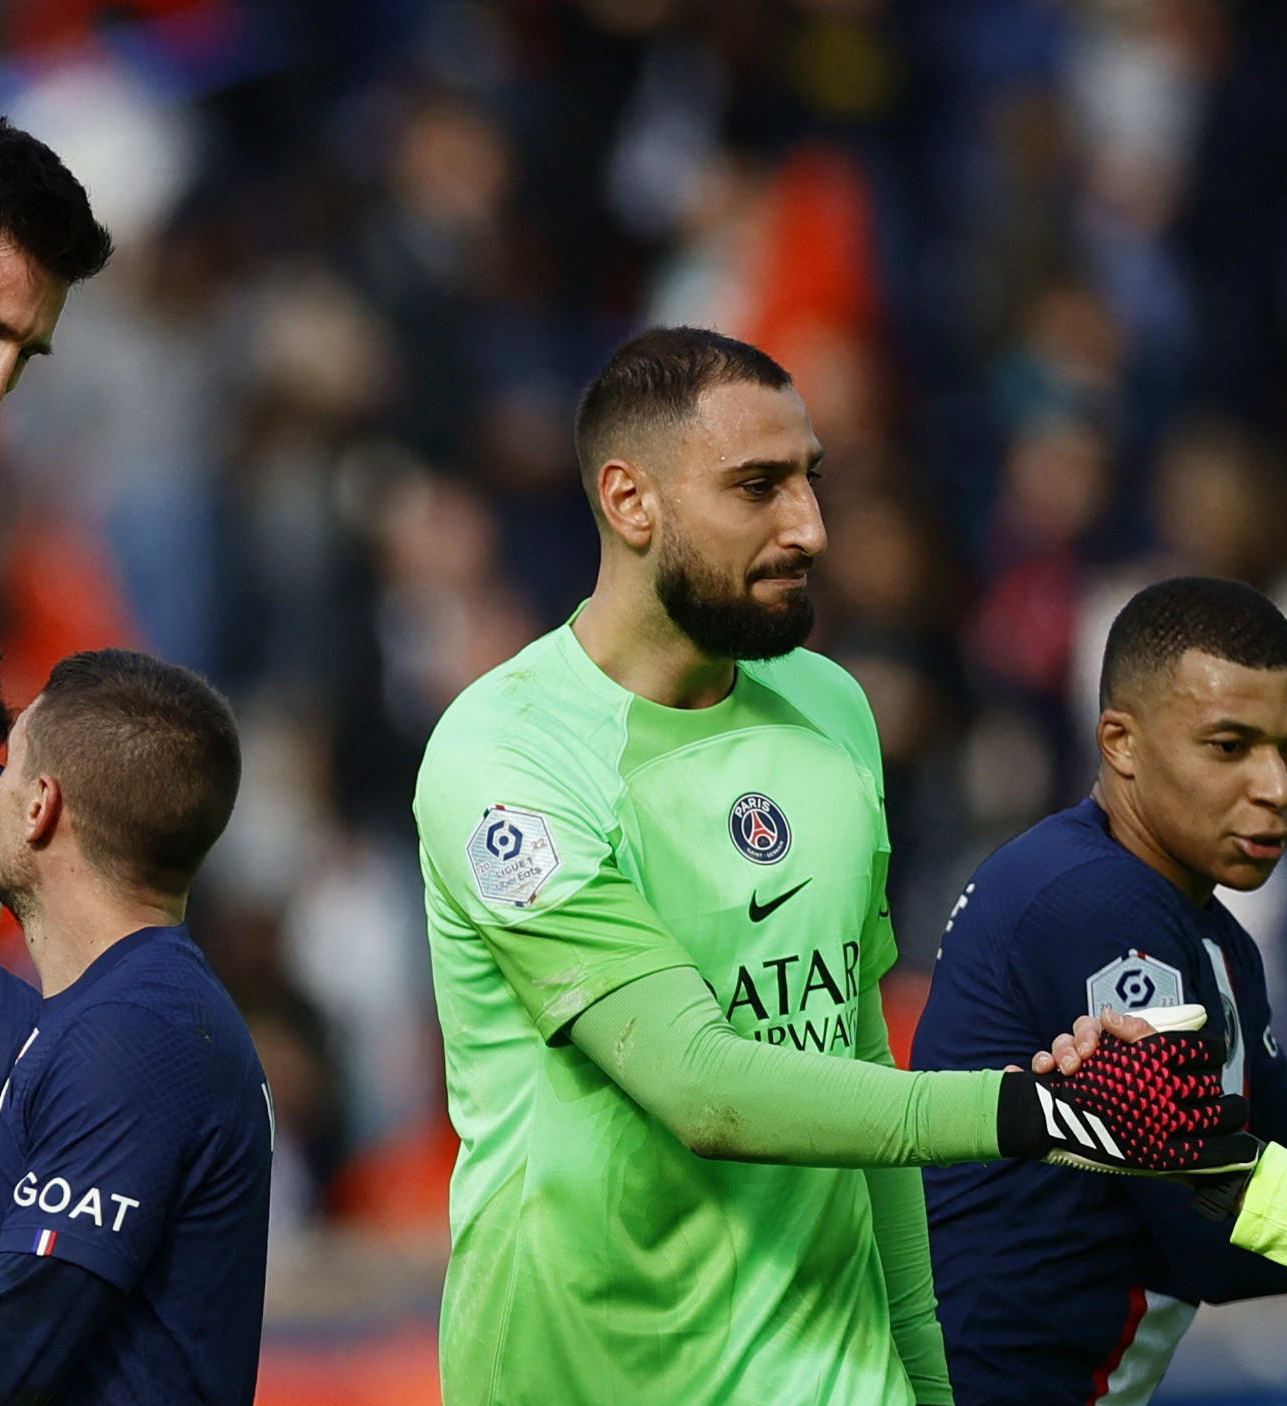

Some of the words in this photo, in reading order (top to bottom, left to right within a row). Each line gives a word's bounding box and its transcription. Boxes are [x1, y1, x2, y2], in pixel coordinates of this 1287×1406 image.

[734, 797, 771, 819] PARIS
[496, 860, 525, 878] LIGUE
[517, 867, 541, 880] Eats
[13, 1171, 140, 1233] GOAT
